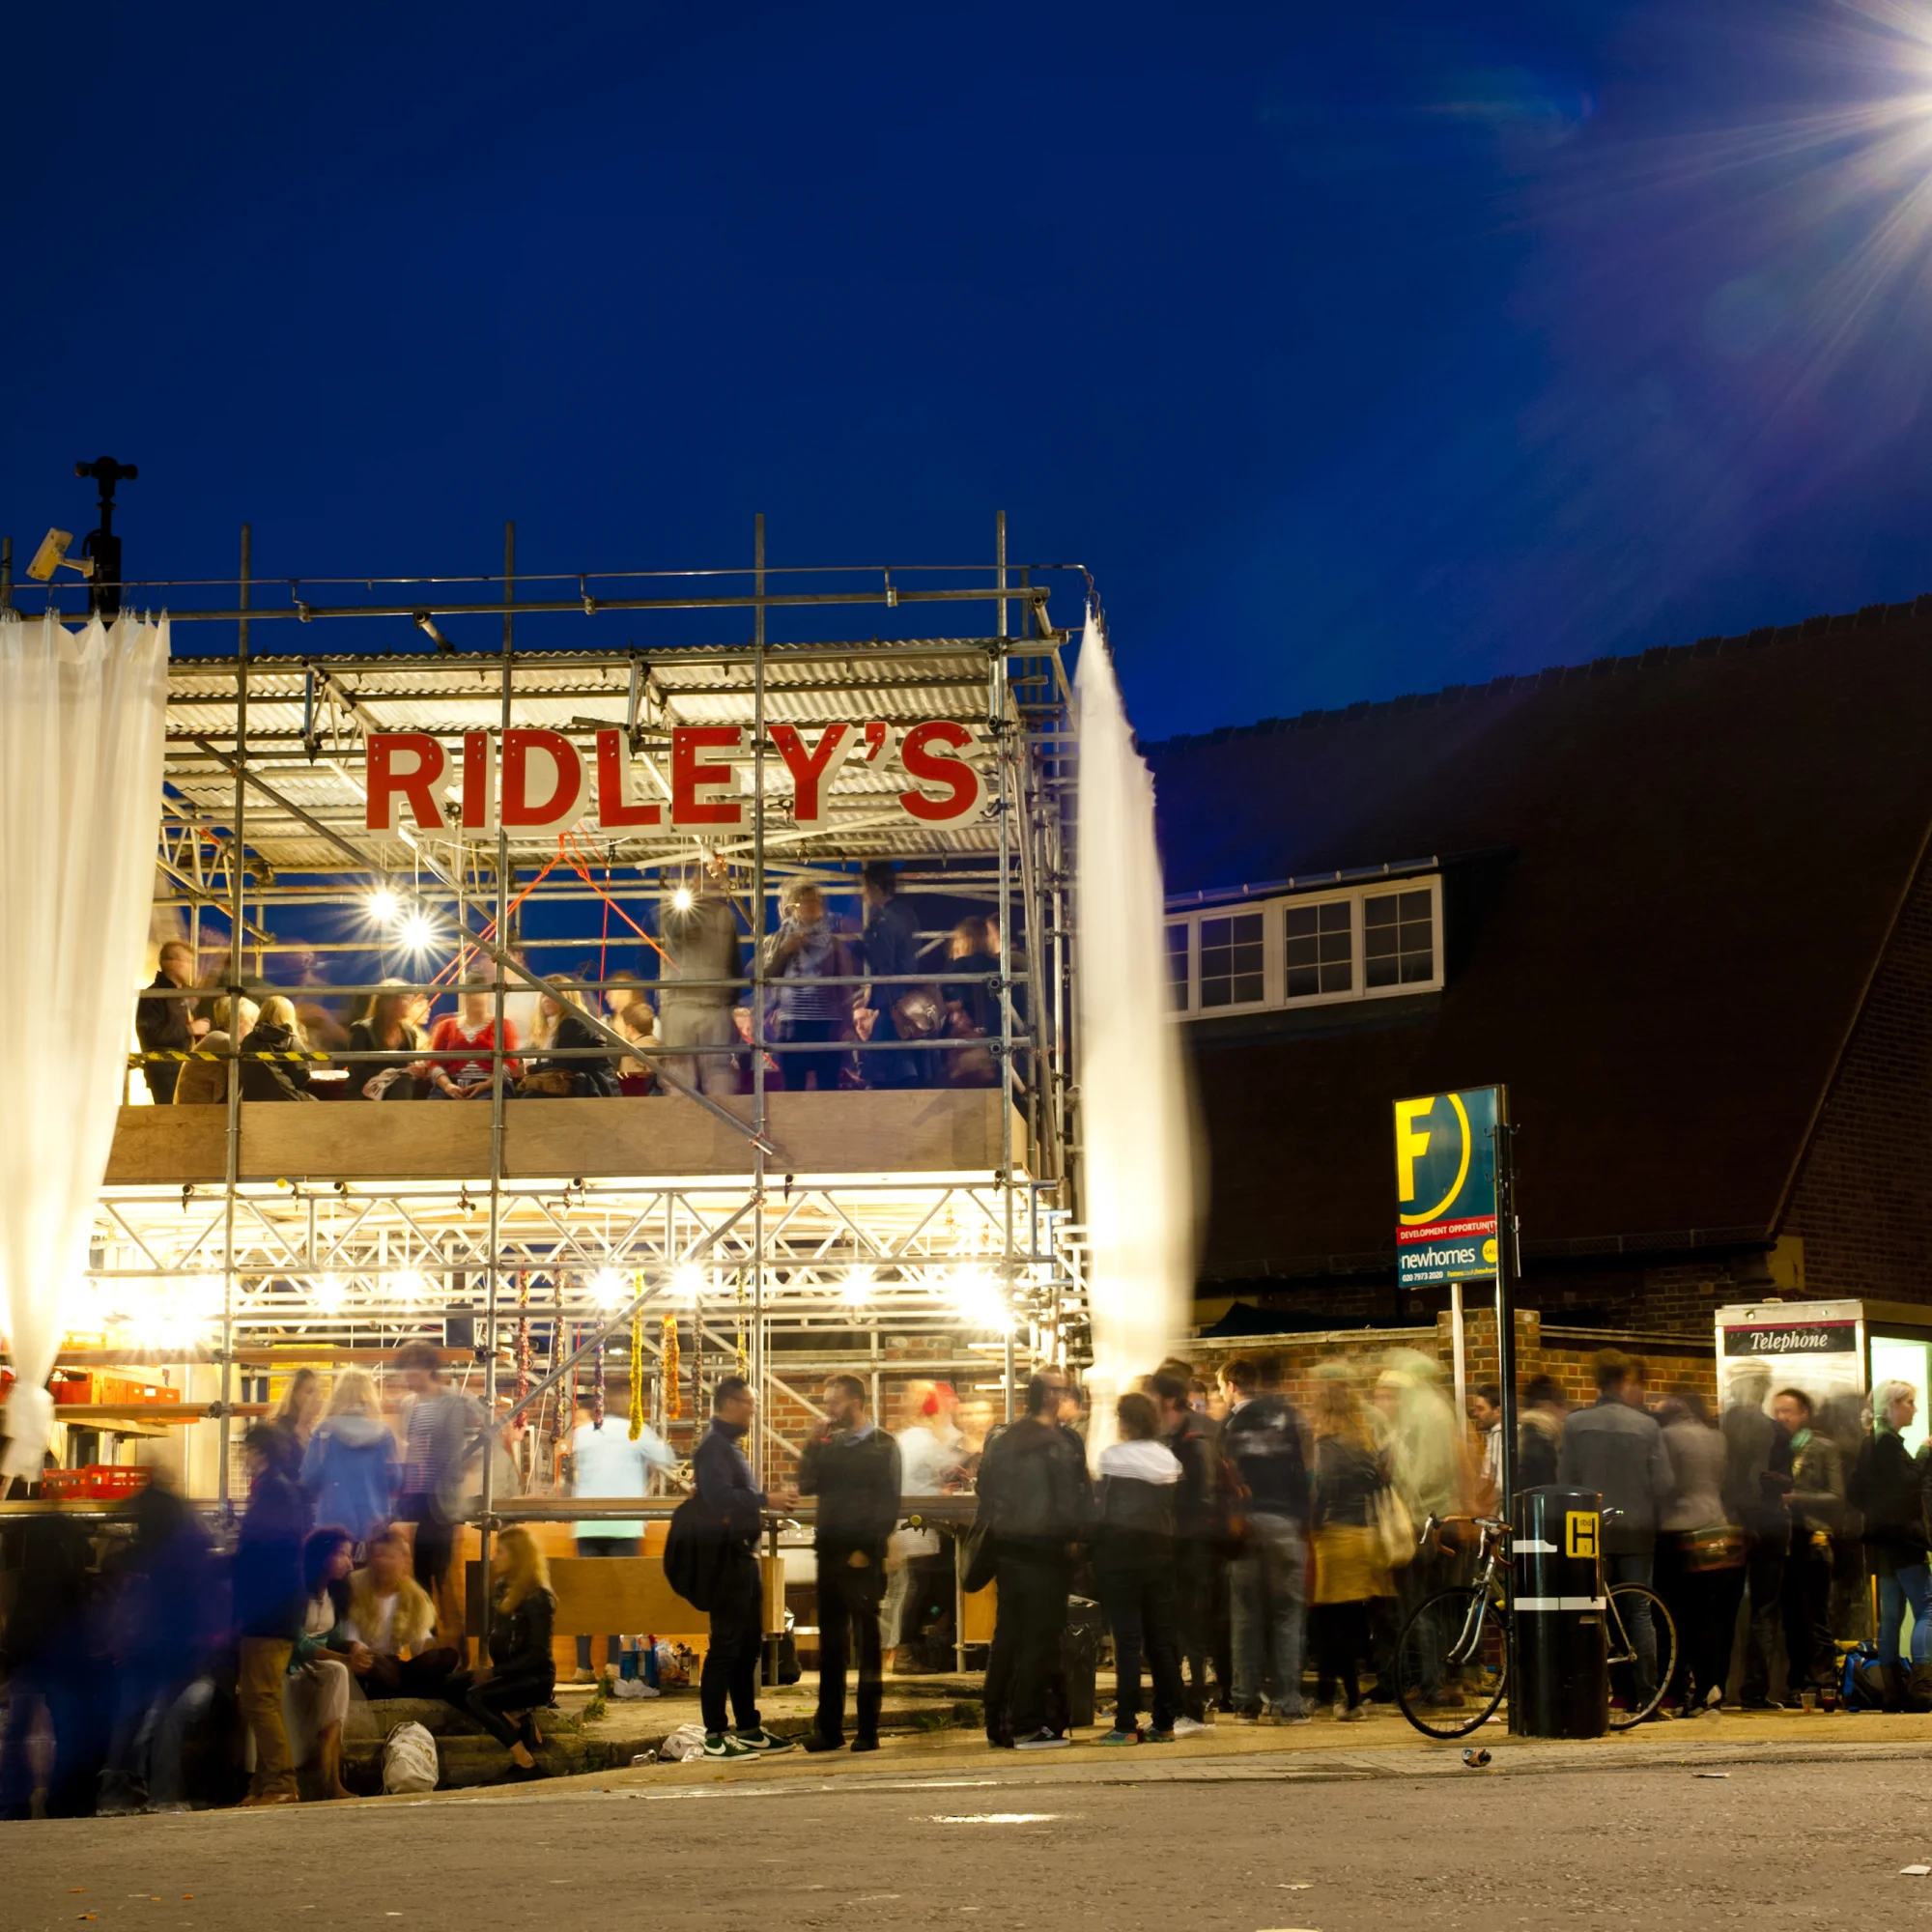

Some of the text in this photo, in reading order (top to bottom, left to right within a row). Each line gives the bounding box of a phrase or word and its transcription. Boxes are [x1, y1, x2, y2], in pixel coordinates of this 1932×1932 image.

[366, 721, 985, 835] RIDLEY'S
[1400, 1226, 1447, 1239] DEVELOPMENT
[1401, 1246, 1476, 1269] newhomes
[1749, 1330, 1829, 1352] Telephone
[1573, 1517, 1595, 1554] H
